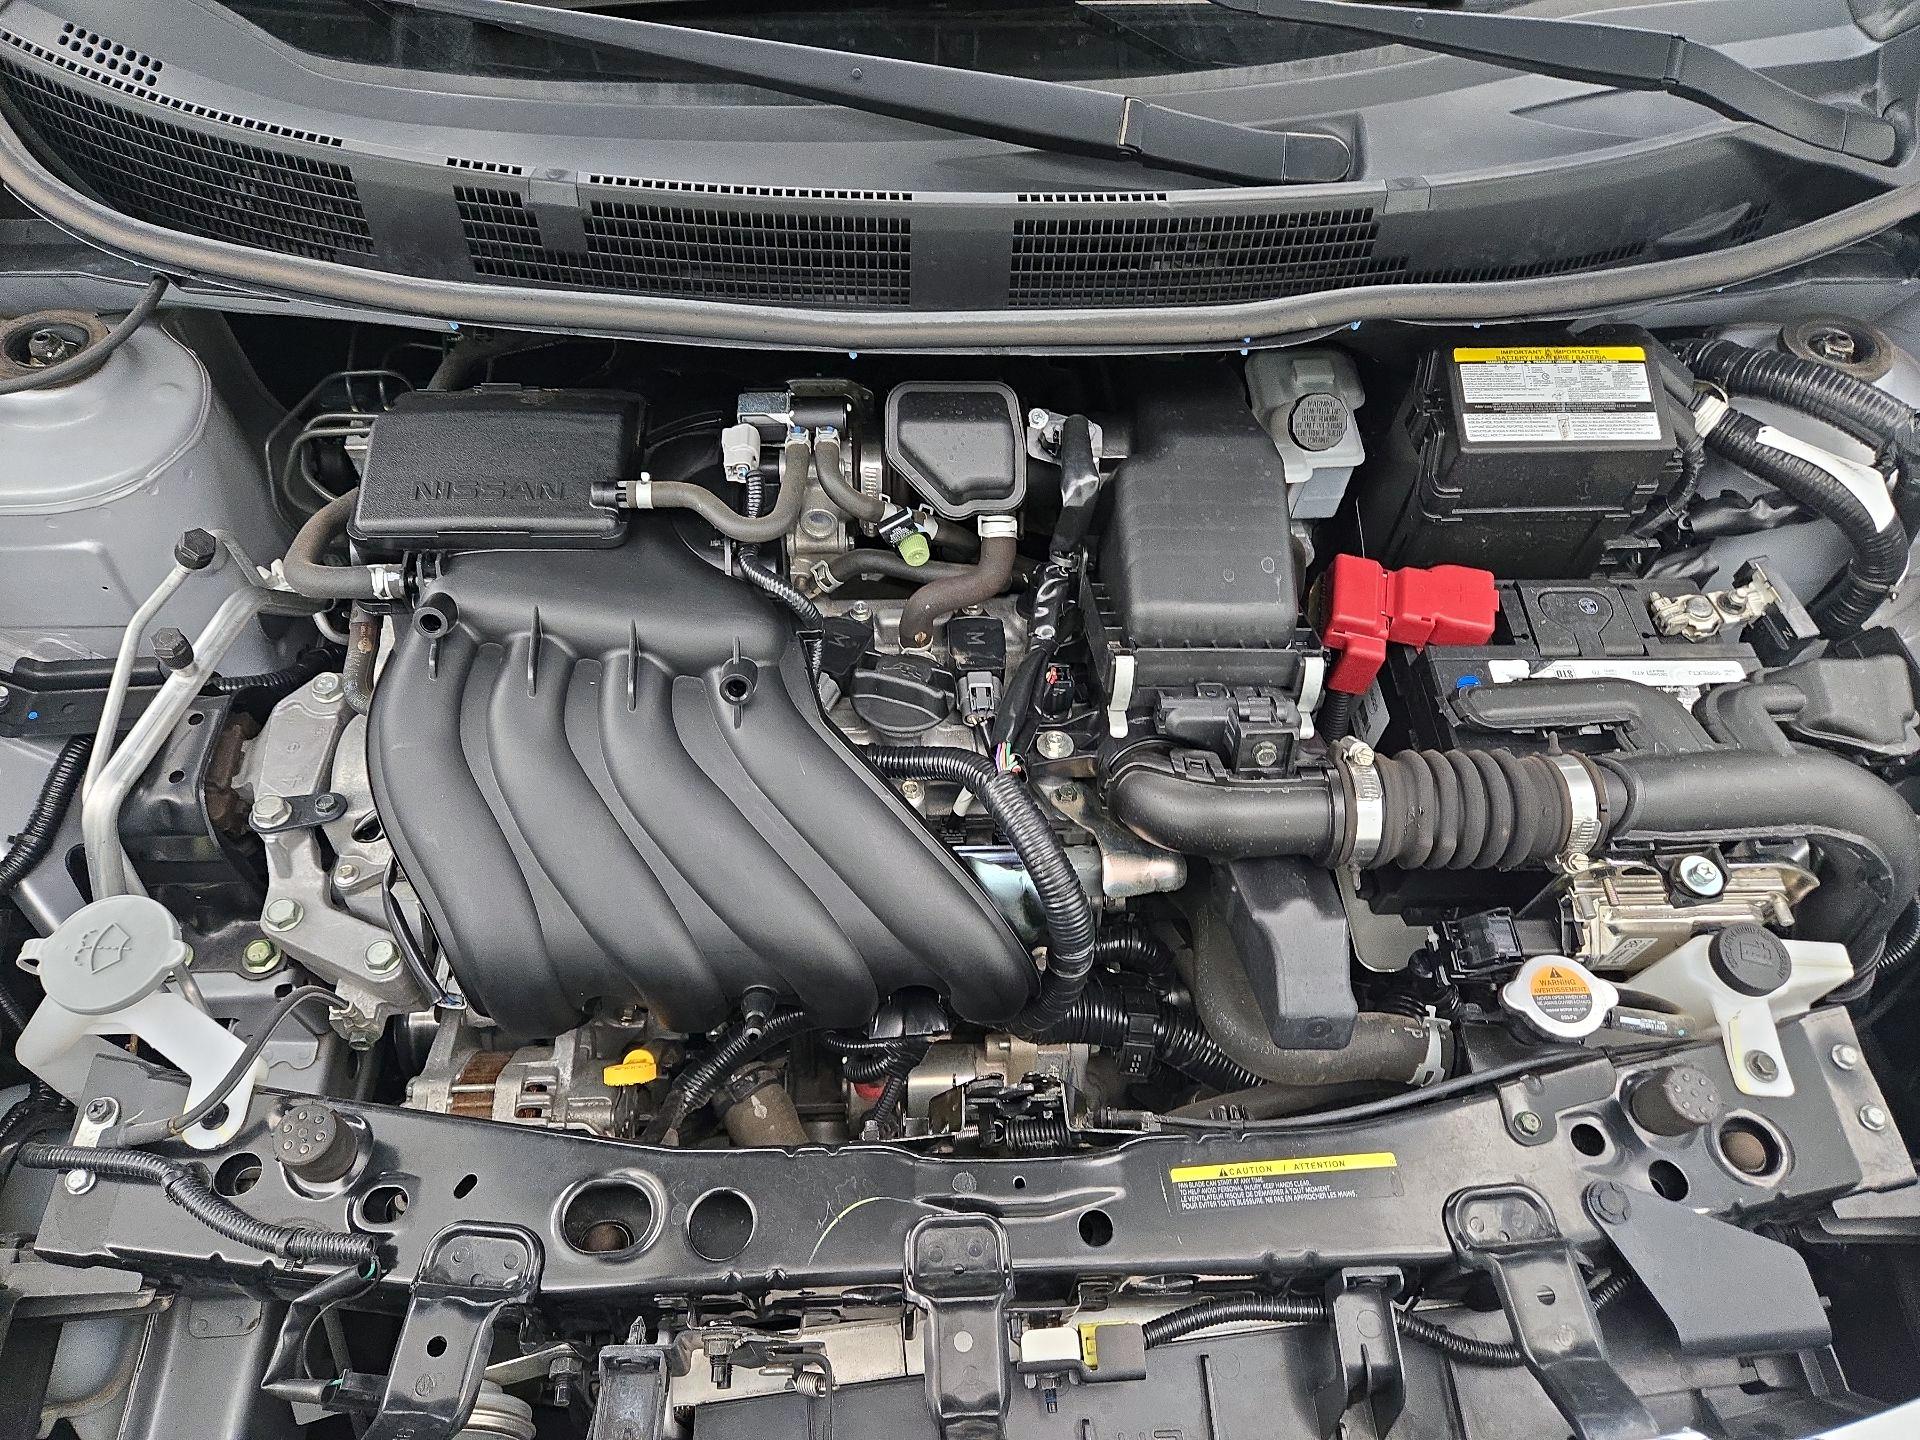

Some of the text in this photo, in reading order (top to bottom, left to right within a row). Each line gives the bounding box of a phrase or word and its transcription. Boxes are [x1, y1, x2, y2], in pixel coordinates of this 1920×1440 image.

[411, 481, 565, 501] NISSAN
[1534, 986, 1587, 994] AVERTISSEMENT
[1229, 1165, 1273, 1176] CAUTION
[1294, 1160, 1346, 1171] ATTENTION
[1178, 1182, 1189, 1190] FAN
[1189, 1181, 1206, 1189] BLADE
[1217, 1178, 1233, 1187] START
[1241, 1177, 1251, 1185] ANY
[1188, 1188, 1200, 1196] HELP
[1201, 1186, 1217, 1194] AVOID
[1217, 1184, 1243, 1193] PERSONAL
[1263, 1182, 1275, 1190] KEEP
[1275, 1181, 1293, 1189] HANDS
[1181, 1202, 1198, 1210] POUR
[1217, 1198, 1236, 1207] TOUTE
[1273, 1195, 1285, 1204] PAS
[1285, 1194, 1293, 1203] EN
[1293, 1192, 1327, 1202] APPROCHER
[1327, 1190, 1338, 1199] LES
[1187, 1193, 1224, 1202] VENTILATEUR
[1224, 1191, 1245, 1200] RISQUE
[1245, 1190, 1253, 1198] DE
[1289, 1186, 1305, 1195] TOUT
